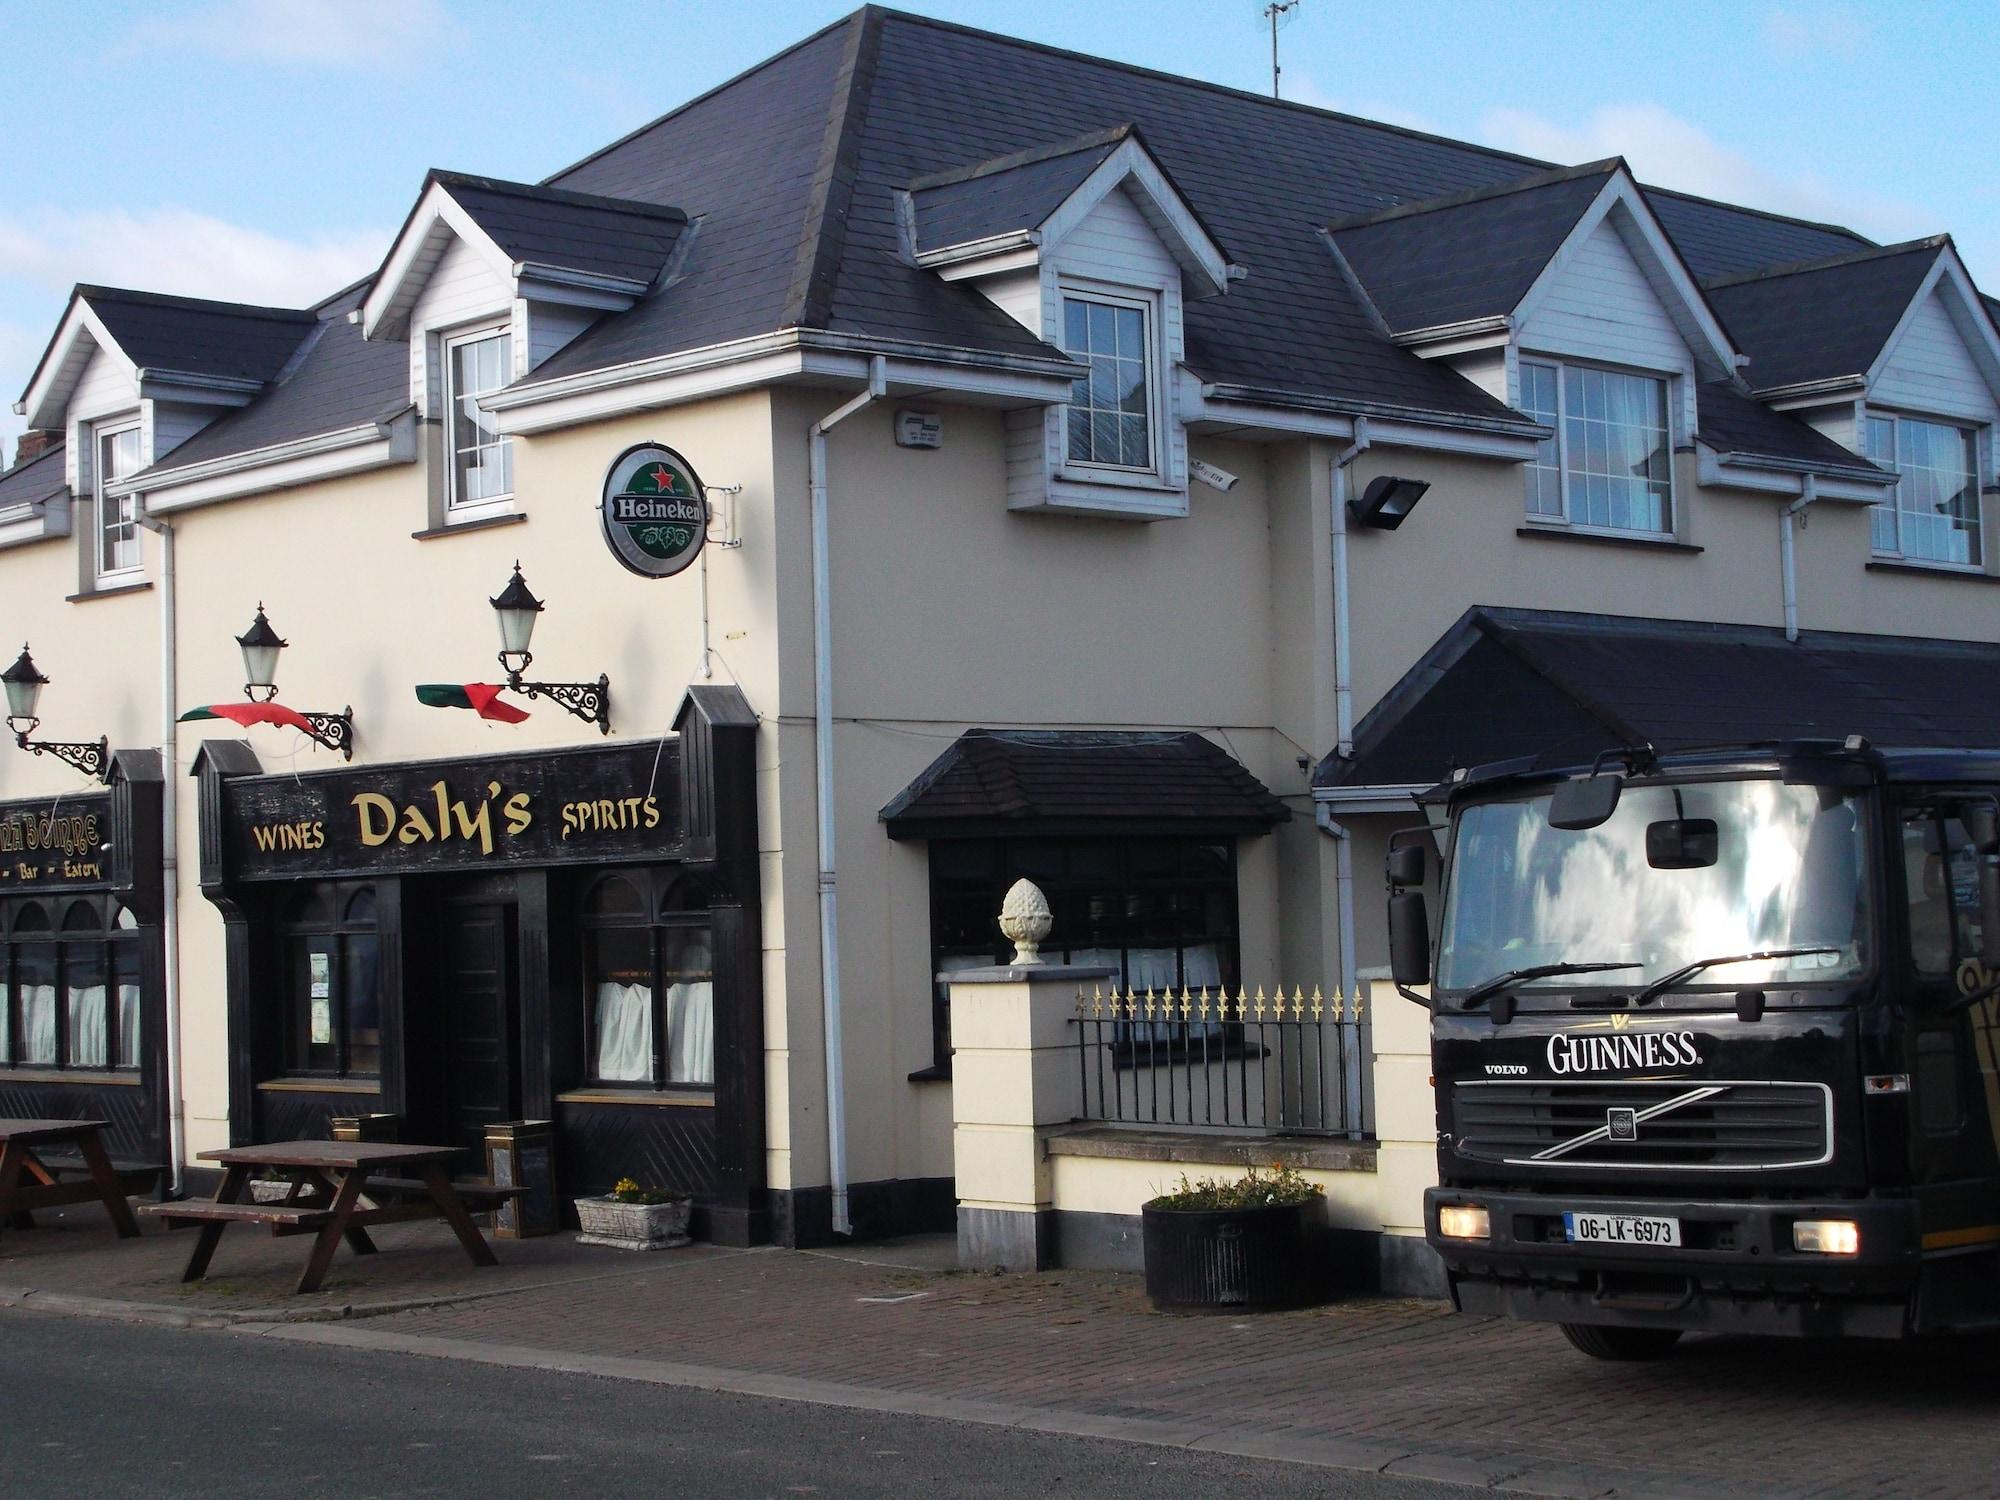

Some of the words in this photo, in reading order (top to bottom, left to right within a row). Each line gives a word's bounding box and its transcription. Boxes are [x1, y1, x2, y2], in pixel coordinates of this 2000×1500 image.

[619, 499, 700, 519] Heineken
[253, 821, 325, 852] WINES
[352, 780, 532, 855] Daly's
[562, 796, 660, 840] SPIRITS
[20, 862, 38, 879] Bar
[64, 860, 100, 880] Eatery
[1547, 1031, 1697, 1074] GUINNESS
[1485, 1065, 1528, 1075] VOLVO
[1579, 1218, 1672, 1243] 06-LK-6973
